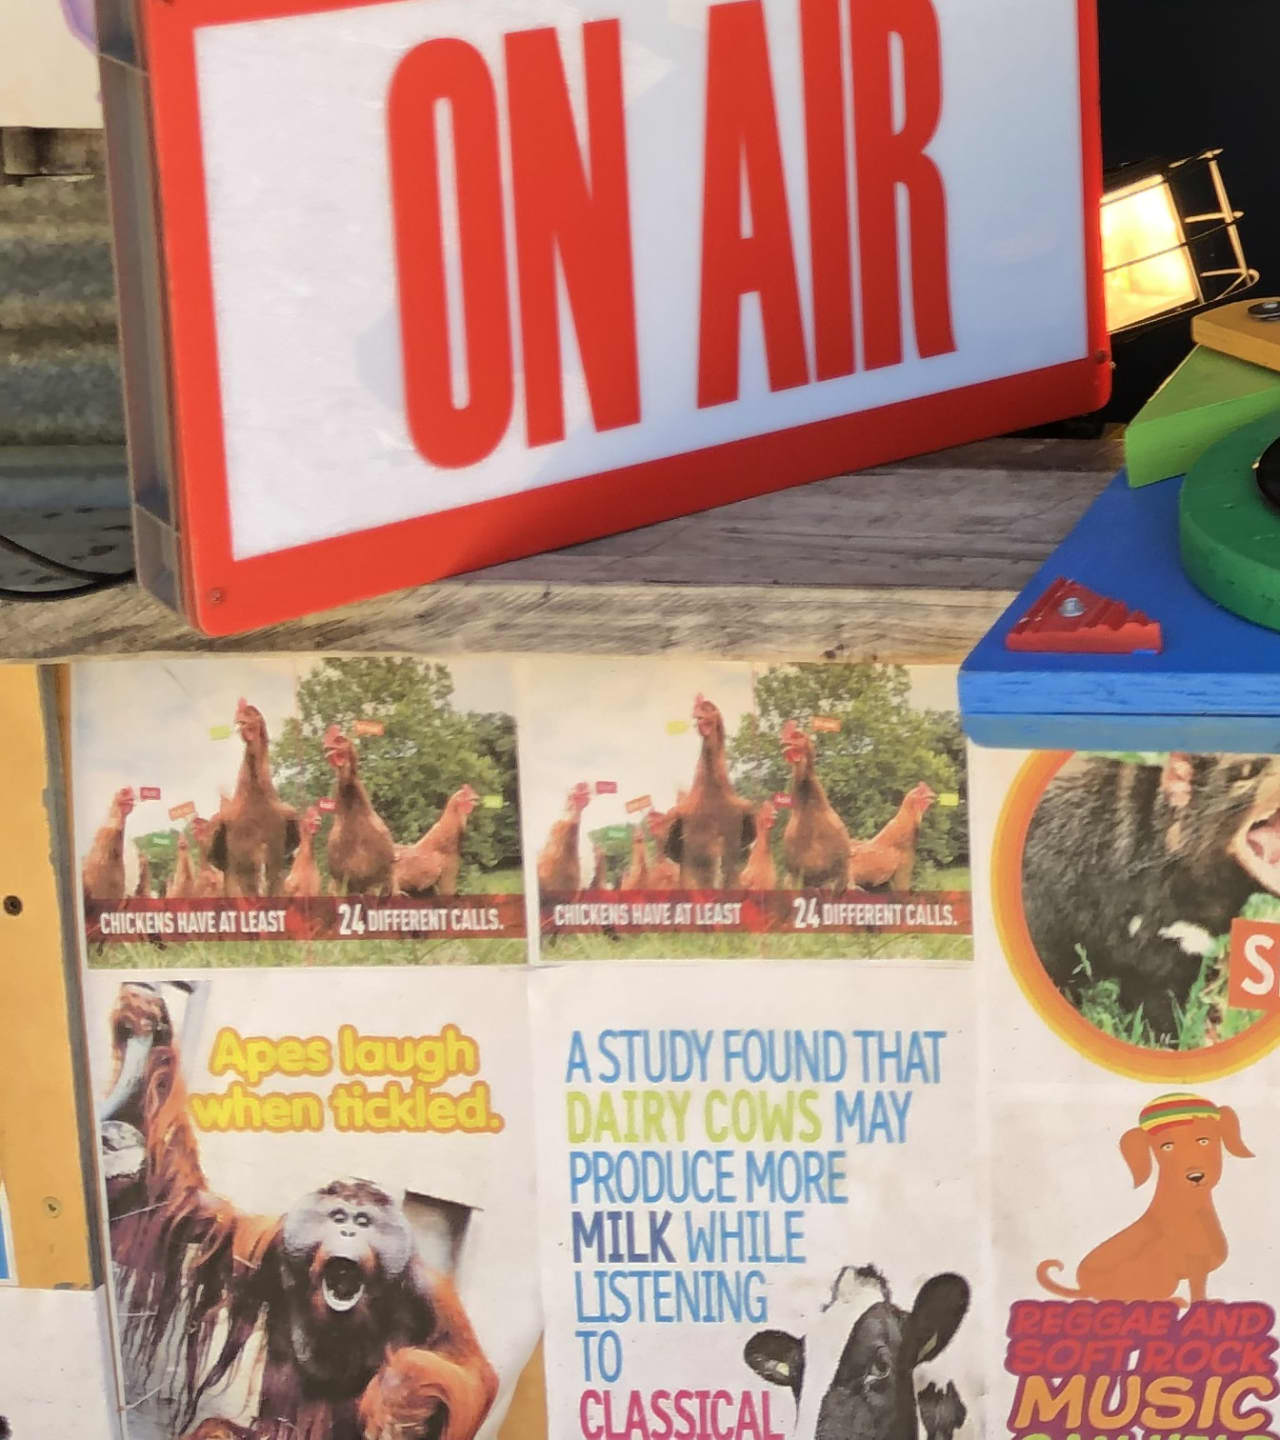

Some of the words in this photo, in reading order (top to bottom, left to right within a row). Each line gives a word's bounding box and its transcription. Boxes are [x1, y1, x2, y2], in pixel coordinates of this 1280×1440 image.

[386, 19, 641, 470] ON
[99, 910, 175, 935] CHICKENS
[177, 910, 217, 934] HAVE
[218, 910, 240, 933] AT
[240, 909, 286, 933] LEAST
[338, 903, 365, 936] 24
[367, 908, 448, 932] DIFFERENT
[450, 907, 504, 931] CALLS.
[554, 903, 629, 926] CHICKENS
[631, 903, 672, 926] HAVE
[674, 903, 694, 925] AT
[695, 902, 742, 925] LEAST
[793, 897, 820, 929] 24
[822, 903, 902, 927] DIFFERENT
[905, 903, 958, 927] CALLS.
[209, 1028, 331, 1085] Apes
[339, 1025, 479, 1084] laugh
[565, 1030, 592, 1083] A
[599, 1029, 713, 1083] STUDY
[722, 1029, 847, 1083] FOUND
[852, 1030, 947, 1083] THAT
[192, 1081, 323, 1131] when
[330, 1081, 503, 1132] tickled.
[565, 1090, 691, 1143] DAIRY
[704, 1089, 823, 1143] COWS
[834, 1090, 913, 1143] MAY
[569, 1150, 735, 1204] PRODUCE
[746, 1150, 848, 1204] MORE
[571, 1210, 677, 1264] MILK
[685, 1210, 806, 1264] WHILE
[575, 1270, 768, 1323] LISTENING
[1011, 1305, 1170, 1336] REGGAE
[1180, 1305, 1269, 1336] AND
[575, 1329, 622, 1383] TO
[1014, 1339, 1134, 1373] SOFT
[1141, 1339, 1273, 1373] ROCK
[579, 1389, 785, 1440] CLASSICAL
[1014, 1374, 1274, 1431] MUSIC
